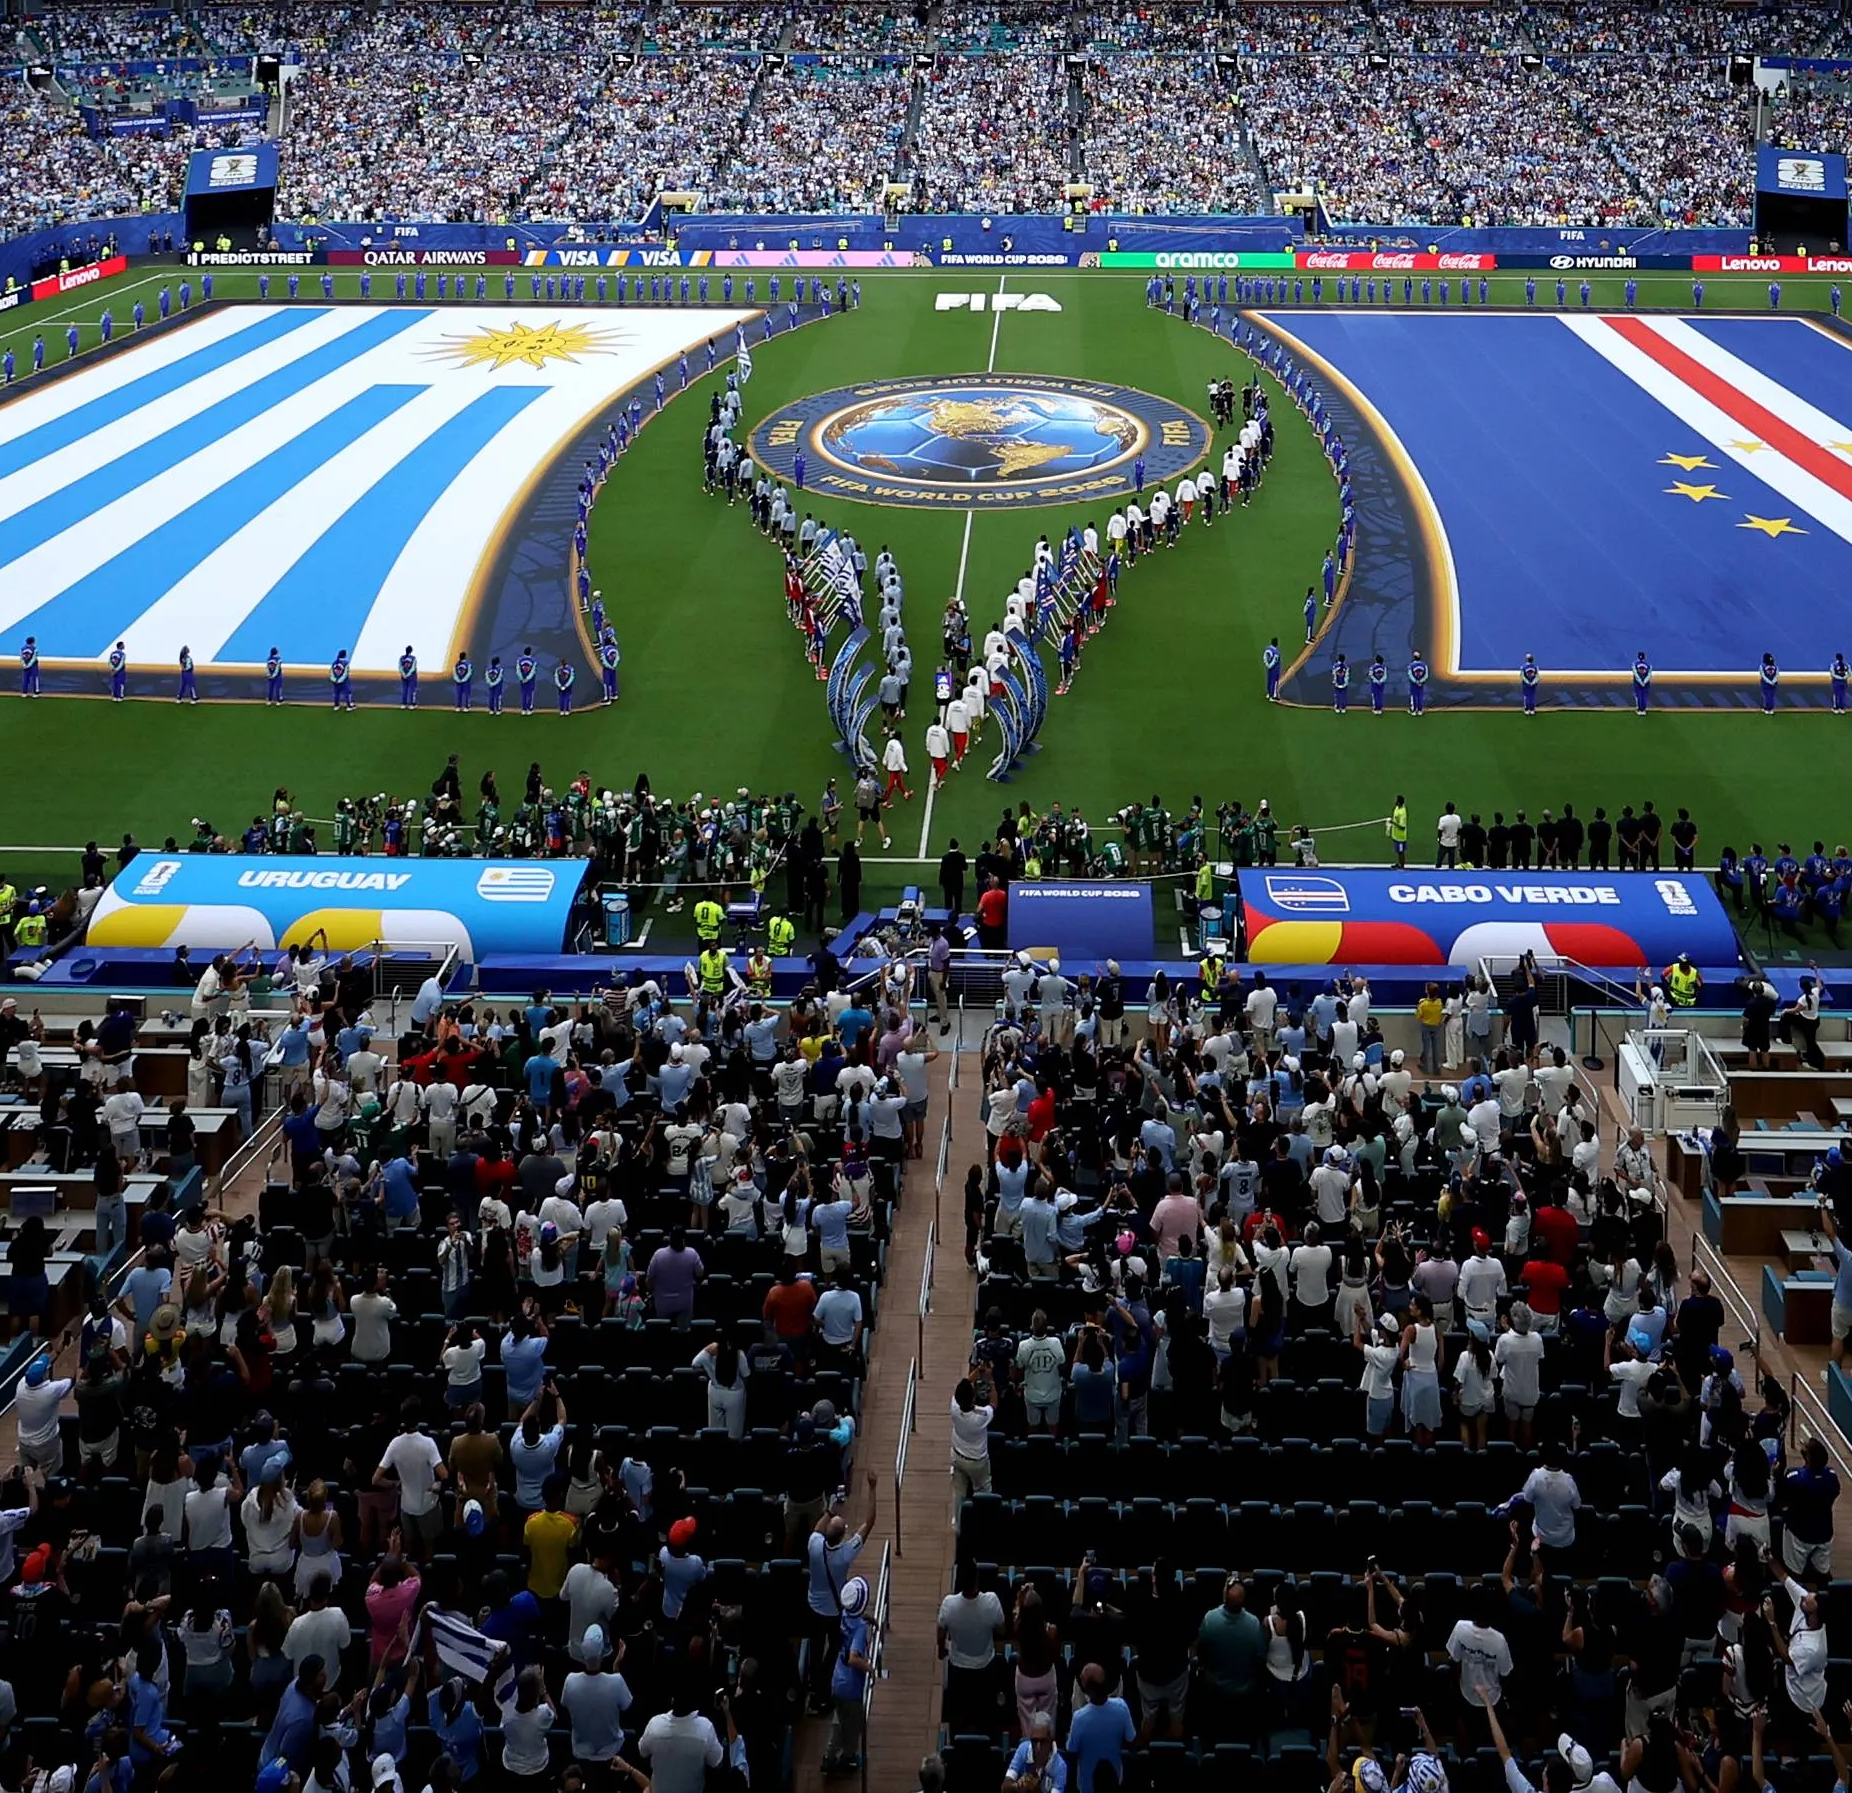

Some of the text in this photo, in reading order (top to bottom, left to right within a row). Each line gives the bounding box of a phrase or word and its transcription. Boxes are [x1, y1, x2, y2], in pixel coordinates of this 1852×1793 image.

[395, 227, 419, 236] FIFA
[1560, 230, 1585, 240] FIFA
[201, 253, 313, 265] PREDICTSTREET
[364, 251, 486, 265] QATAR AIRWAYS
[556, 250, 599, 266] VISA
[638, 250, 681, 266] VISA
[941, 255, 1065, 264] FIFA WORLD CUP 2026
[1156, 252, 1239, 268] aramco
[1577, 257, 1636, 268] HYUNDAI
[1721, 257, 1781, 271] Lenovo
[59, 268, 100, 291] Lenovo
[935, 293, 1063, 311] FIFA
[769, 420, 804, 447] FIFA
[1160, 420, 1190, 446] FIFA
[820, 475, 1127, 501] FIFA WORLD CUP 2026
[238, 871, 413, 892] URUGUAY
[1103, 890, 1140, 898] 2026
[1388, 885, 1621, 906] CABO VERDE
[233, 1069, 242, 1085] 8
[356, 1134, 368, 1148] 11
[581, 1175, 597, 1189] 10
[1239, 1179, 1249, 1194] 8
